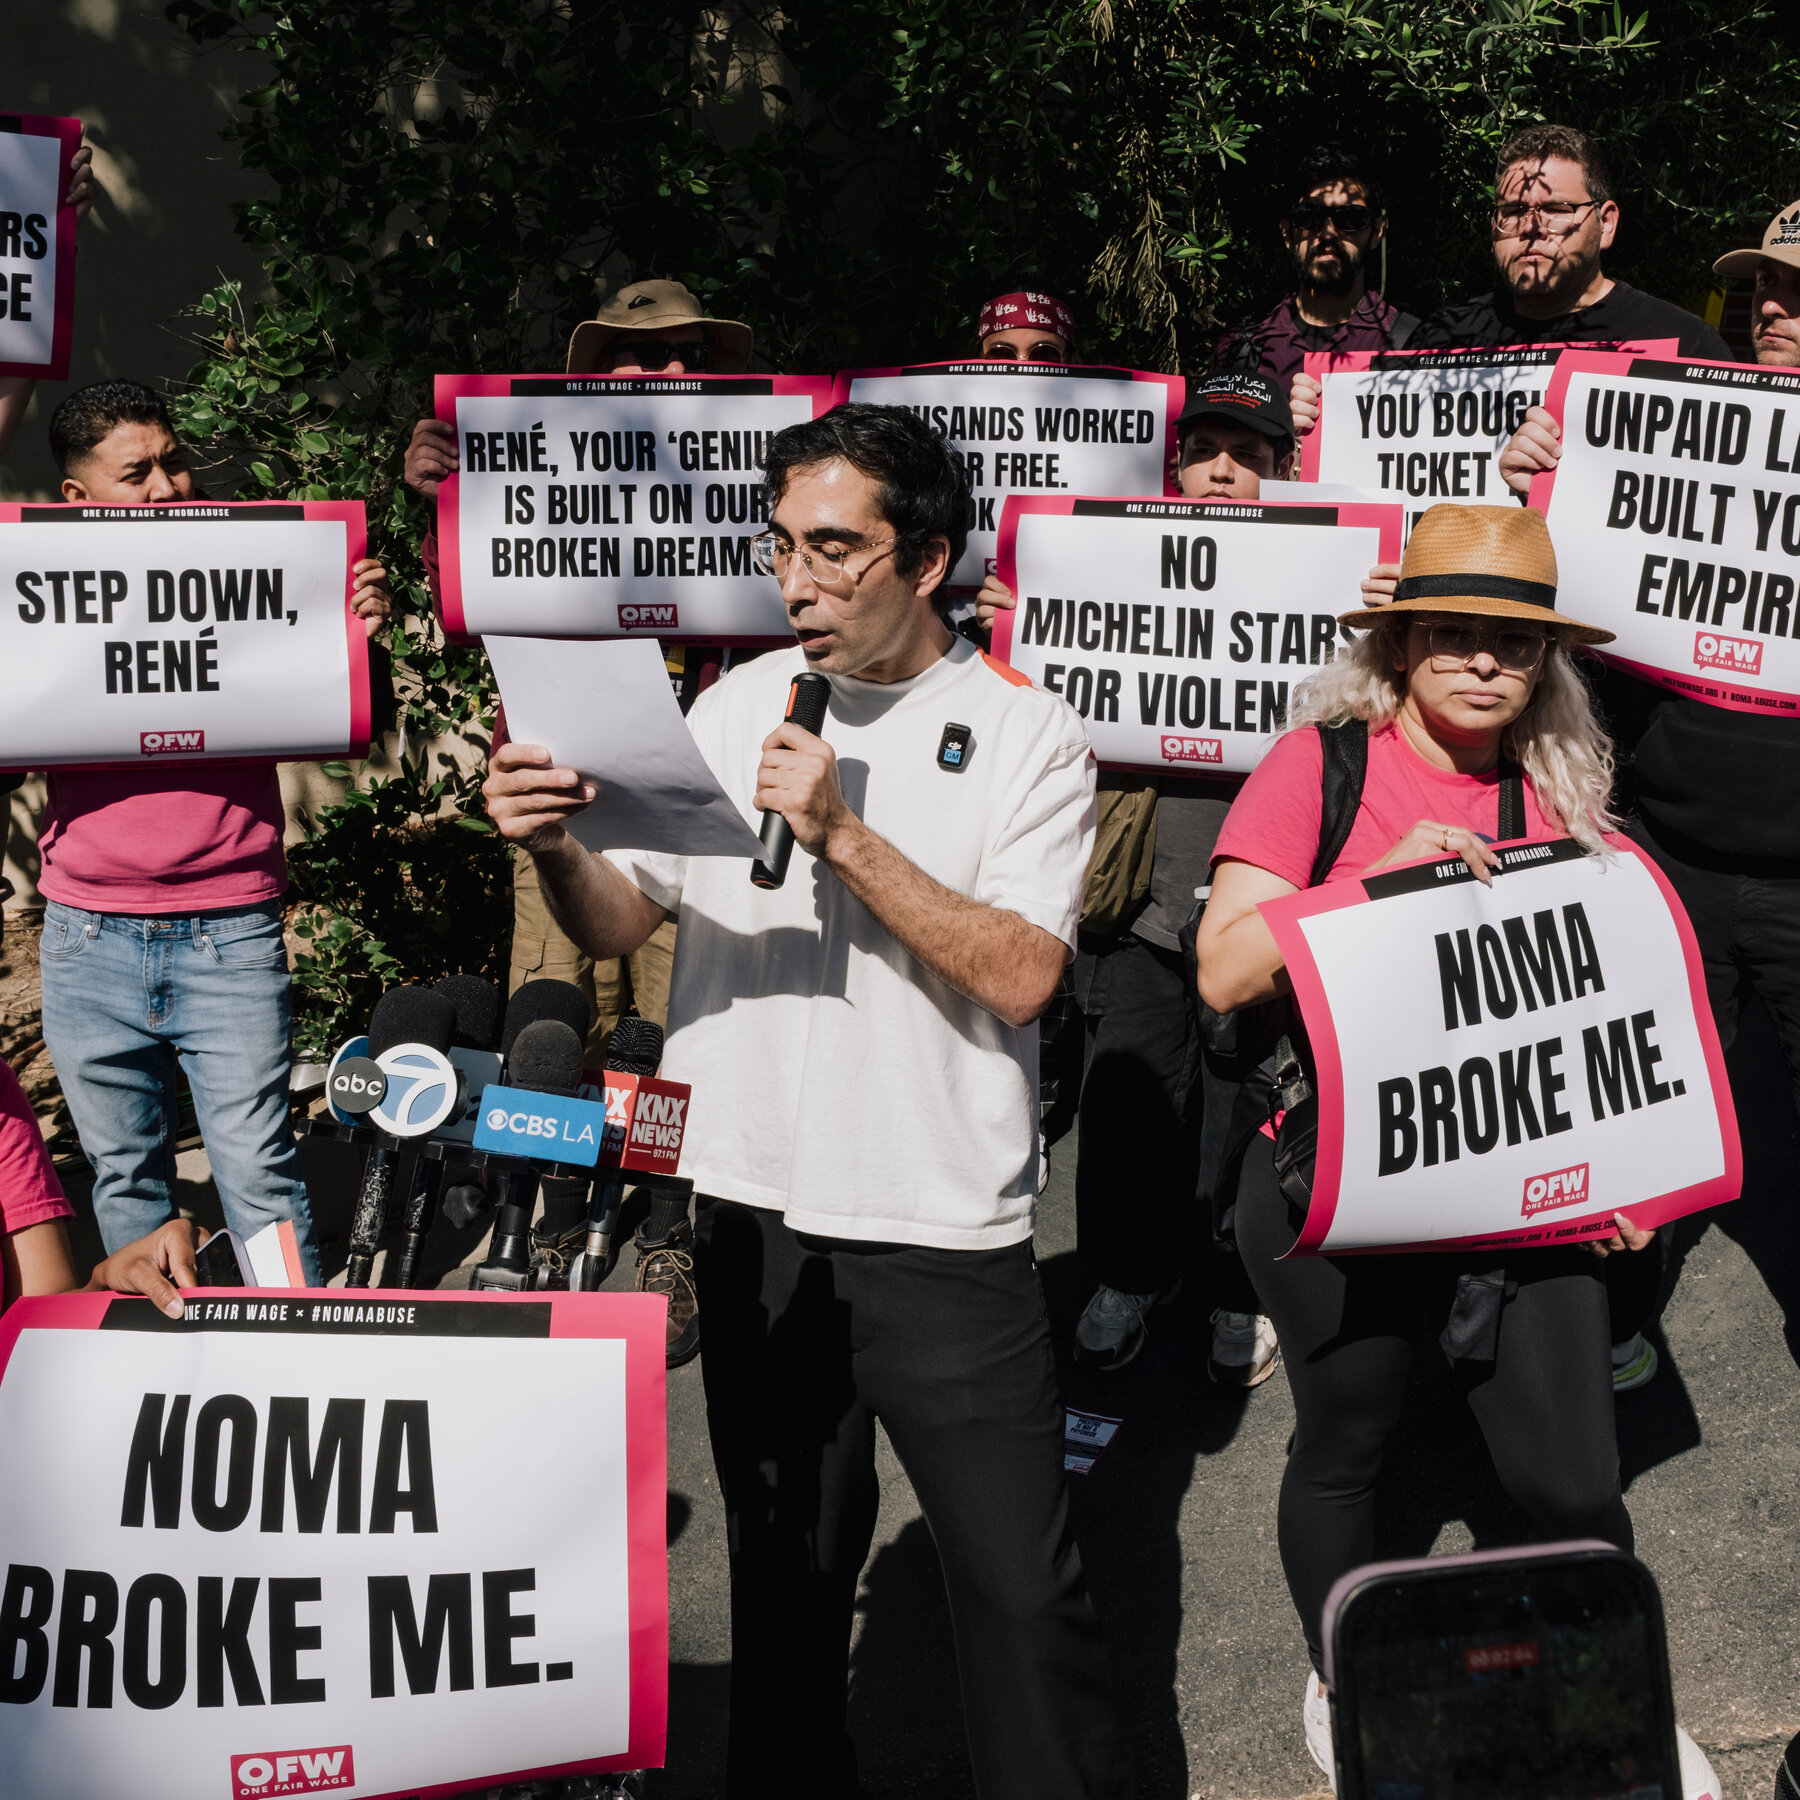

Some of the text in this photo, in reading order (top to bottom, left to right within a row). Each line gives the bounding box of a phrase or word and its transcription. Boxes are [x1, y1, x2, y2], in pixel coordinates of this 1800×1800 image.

[1419, 356, 1435, 365] ONE
[1437, 356, 1456, 365] FAIR
[1459, 355, 1481, 364] WAGE
[1686, 367, 1706, 379] ONE
[1707, 369, 1730, 381] FAIR
[1732, 372, 1759, 384] WAGE
[566, 382, 584, 391] ONE
[586, 382, 606, 391] FAIR
[608, 382, 633, 391] WAGE
[645, 381, 702, 391] #NOMAABUSE
[1035, 407, 1155, 444] WORKED
[1355, 393, 1420, 439] YOU
[1585, 387, 1800, 475] UNPAID L
[465, 420, 559, 477] RENÉ,
[569, 430, 657, 473] YOUR
[995, 452, 1069, 488] FREE.
[1377, 451, 1492, 498] TICKET
[82, 509, 101, 518] ONE
[104, 509, 126, 518] FAIR
[129, 509, 156, 518] WAGE
[168, 508, 231, 518] #NOMAABUSE
[504, 484, 771, 525] IS BUILT ON OUR
[1126, 503, 1144, 514] ONE
[1146, 504, 1165, 515] FAIR
[1168, 505, 1192, 516] WAGE
[1203, 506, 1263, 518] #NOMAABUSE
[1606, 469, 1737, 546] BUILT
[491, 537, 621, 578] BROKEN
[1161, 534, 1218, 592] NO
[15, 568, 299, 626] STEP DOWN,
[621, 606, 674, 622] OFW
[1021, 597, 1215, 660] MICHELIN
[104, 625, 220, 694] RENÉ
[1697, 654, 1757, 671] ONE FAIR WAGE
[1698, 635, 1760, 664] OFW
[1043, 663, 1291, 735] FOR VIOLEN
[143, 732, 200, 749] OFW
[1164, 738, 1219, 755] OFW
[1435, 864, 1455, 878] ONE
[1434, 902, 1606, 1032] NOMA
[333, 1073, 383, 1096] abc
[1378, 1009, 1687, 1178] BROKE ME.
[635, 1092, 687, 1128] KNX
[508, 1112, 595, 1146] CBS LA
[631, 1121, 682, 1149] NEWS
[1525, 1191, 1586, 1211] ONE FAIR WAGE
[1527, 1168, 1586, 1200] OFW
[184, 1304, 201, 1321] ONE
[205, 1303, 240, 1321] FAIR
[246, 1304, 288, 1322] WAGE
[311, 1306, 416, 1325] #NOMAABUSE
[121, 1393, 439, 1534] NOMA
[0, 1563, 573, 1711] BROKE ME.
[237, 1751, 346, 1786] OFW
[240, 1775, 349, 1797] ONE FAIR WAGE
